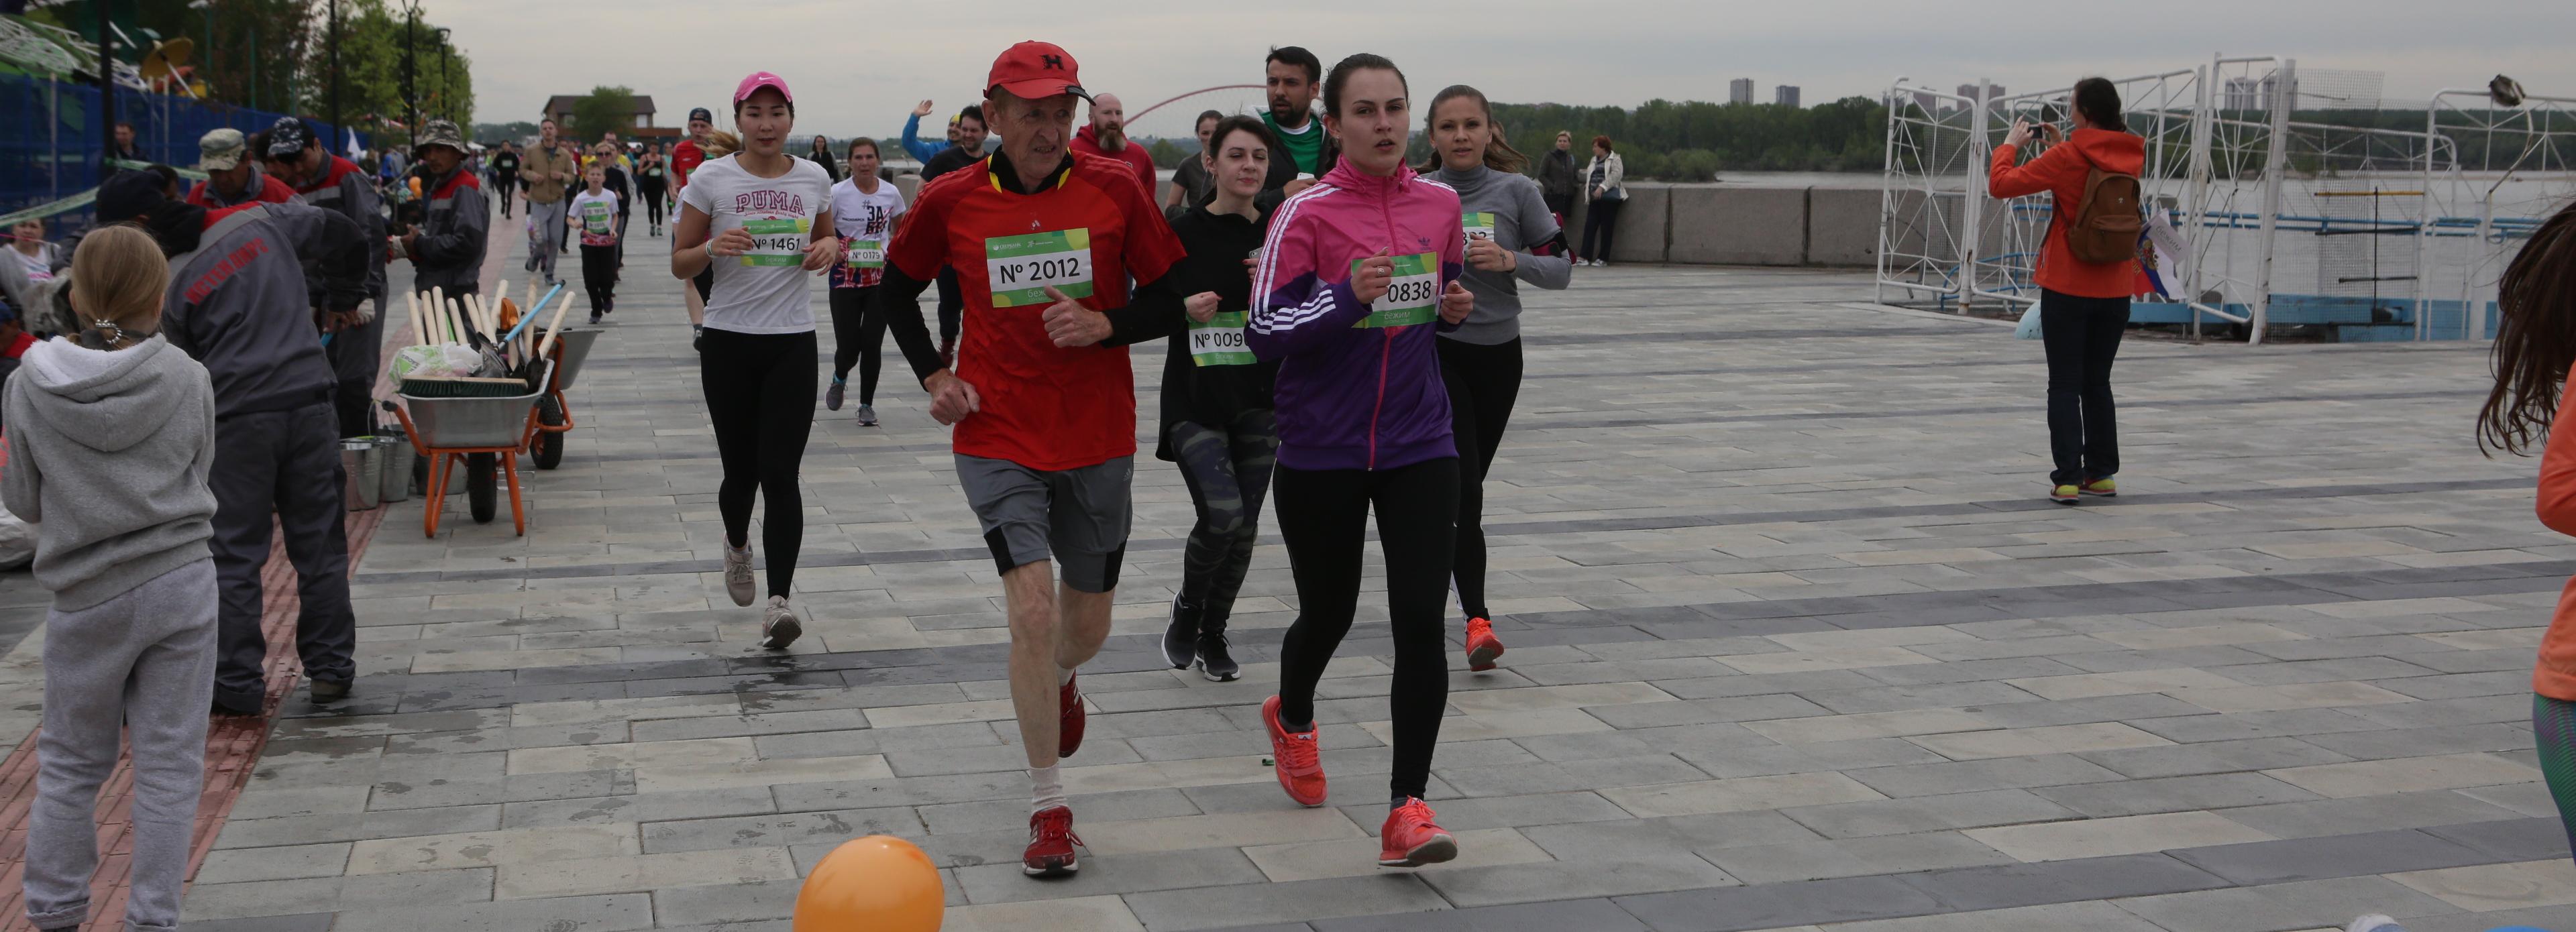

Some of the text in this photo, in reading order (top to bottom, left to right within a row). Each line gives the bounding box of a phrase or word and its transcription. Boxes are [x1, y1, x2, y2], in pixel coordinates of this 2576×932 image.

[736, 190, 805, 216] PUMA
[770, 238, 800, 250] 1461
[1028, 257, 1080, 281] 2012
[1027, 290, 1046, 298] беж
[1387, 280, 1432, 302] 0838
[1214, 333, 1244, 347] 009
